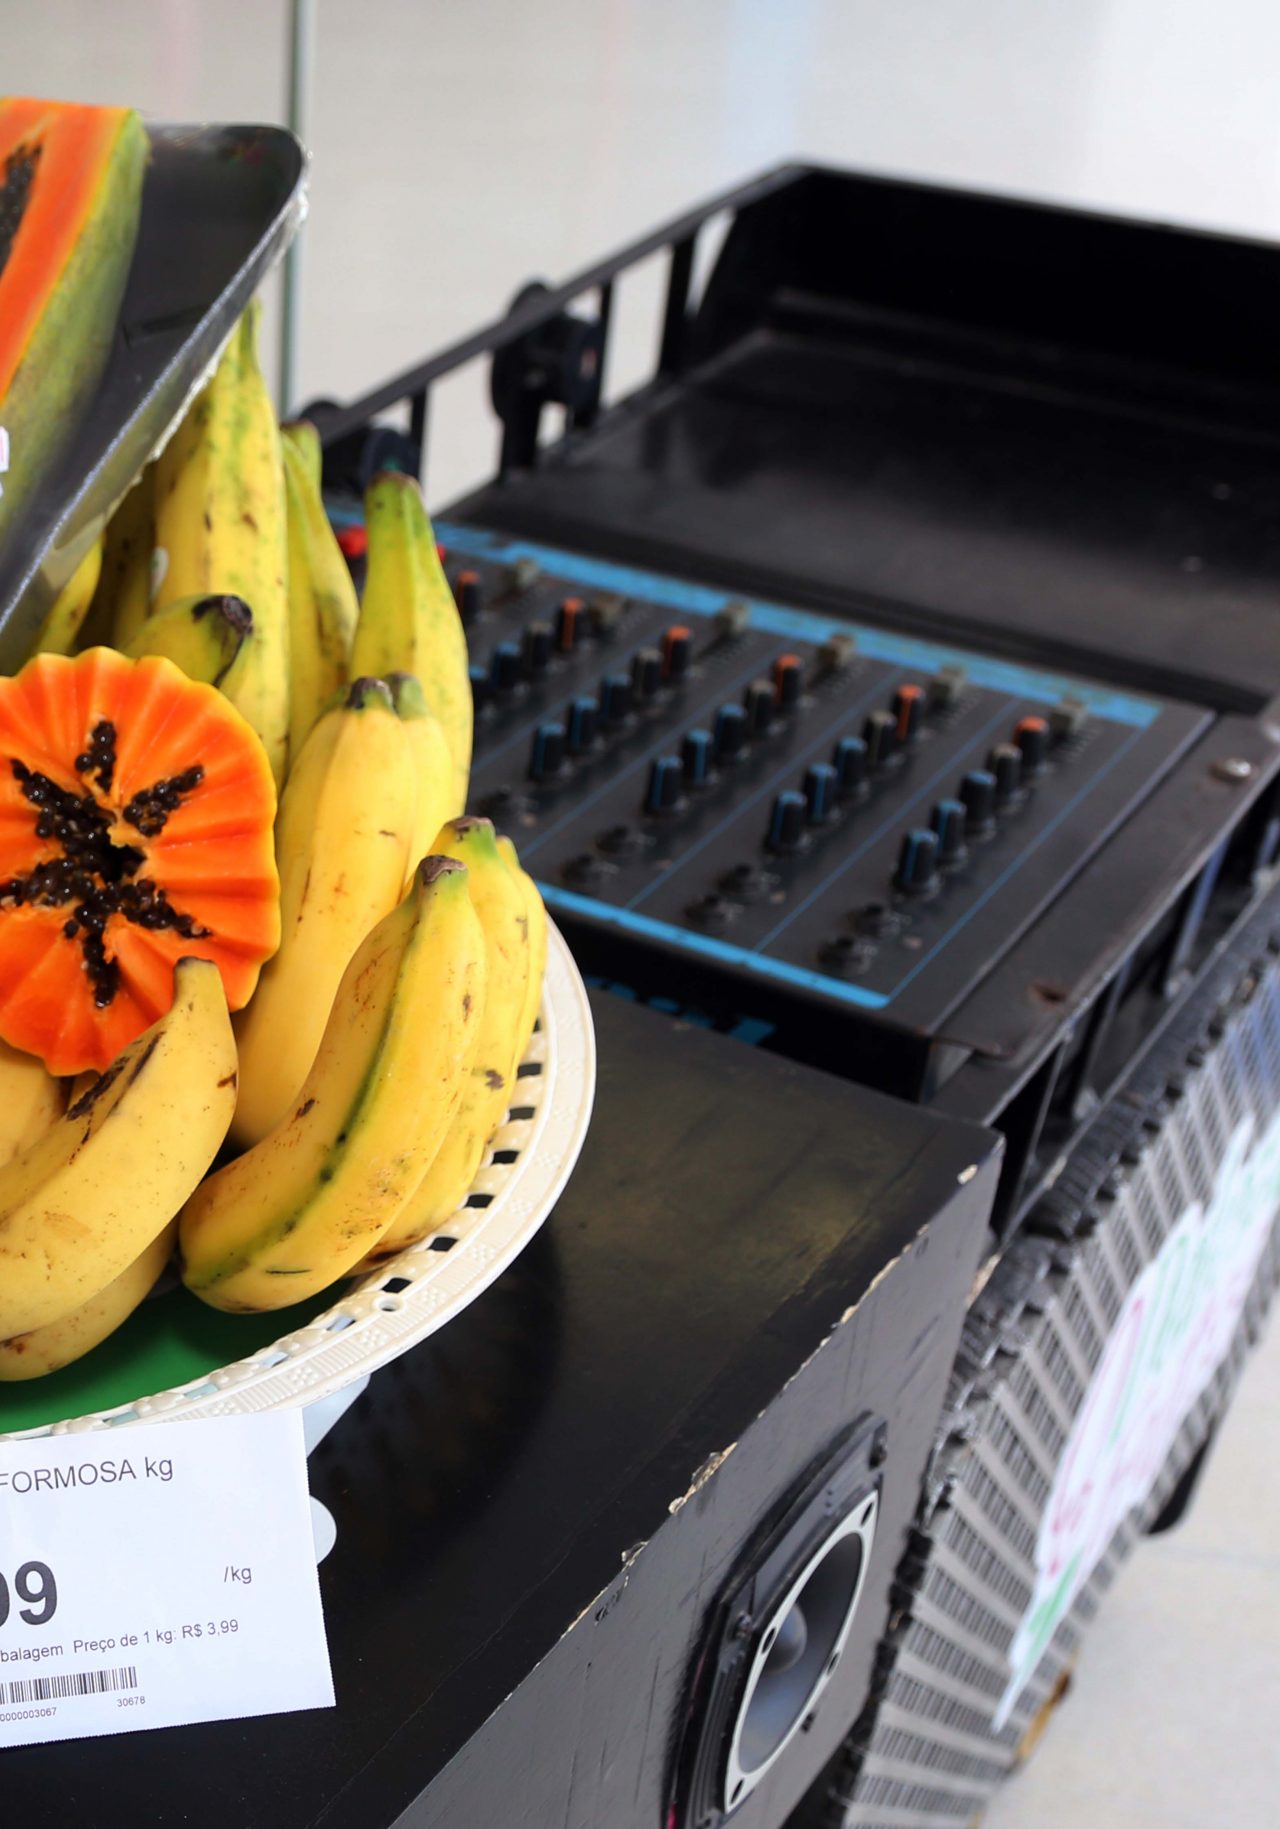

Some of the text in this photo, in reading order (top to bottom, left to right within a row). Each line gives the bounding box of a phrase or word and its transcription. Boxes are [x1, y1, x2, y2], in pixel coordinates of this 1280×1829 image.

[144, 1456, 173, 1482] kg
[223, 1565, 252, 1585] /kg
[72, 1638, 116, 1654] Preço
[119, 1633, 138, 1647] de
[143, 1630, 150, 1644] 1
[155, 1629, 177, 1645] kg:
[181, 1623, 203, 1639] R$
[206, 1618, 239, 1636] 3,99
[116, 1695, 146, 1708] 30678
